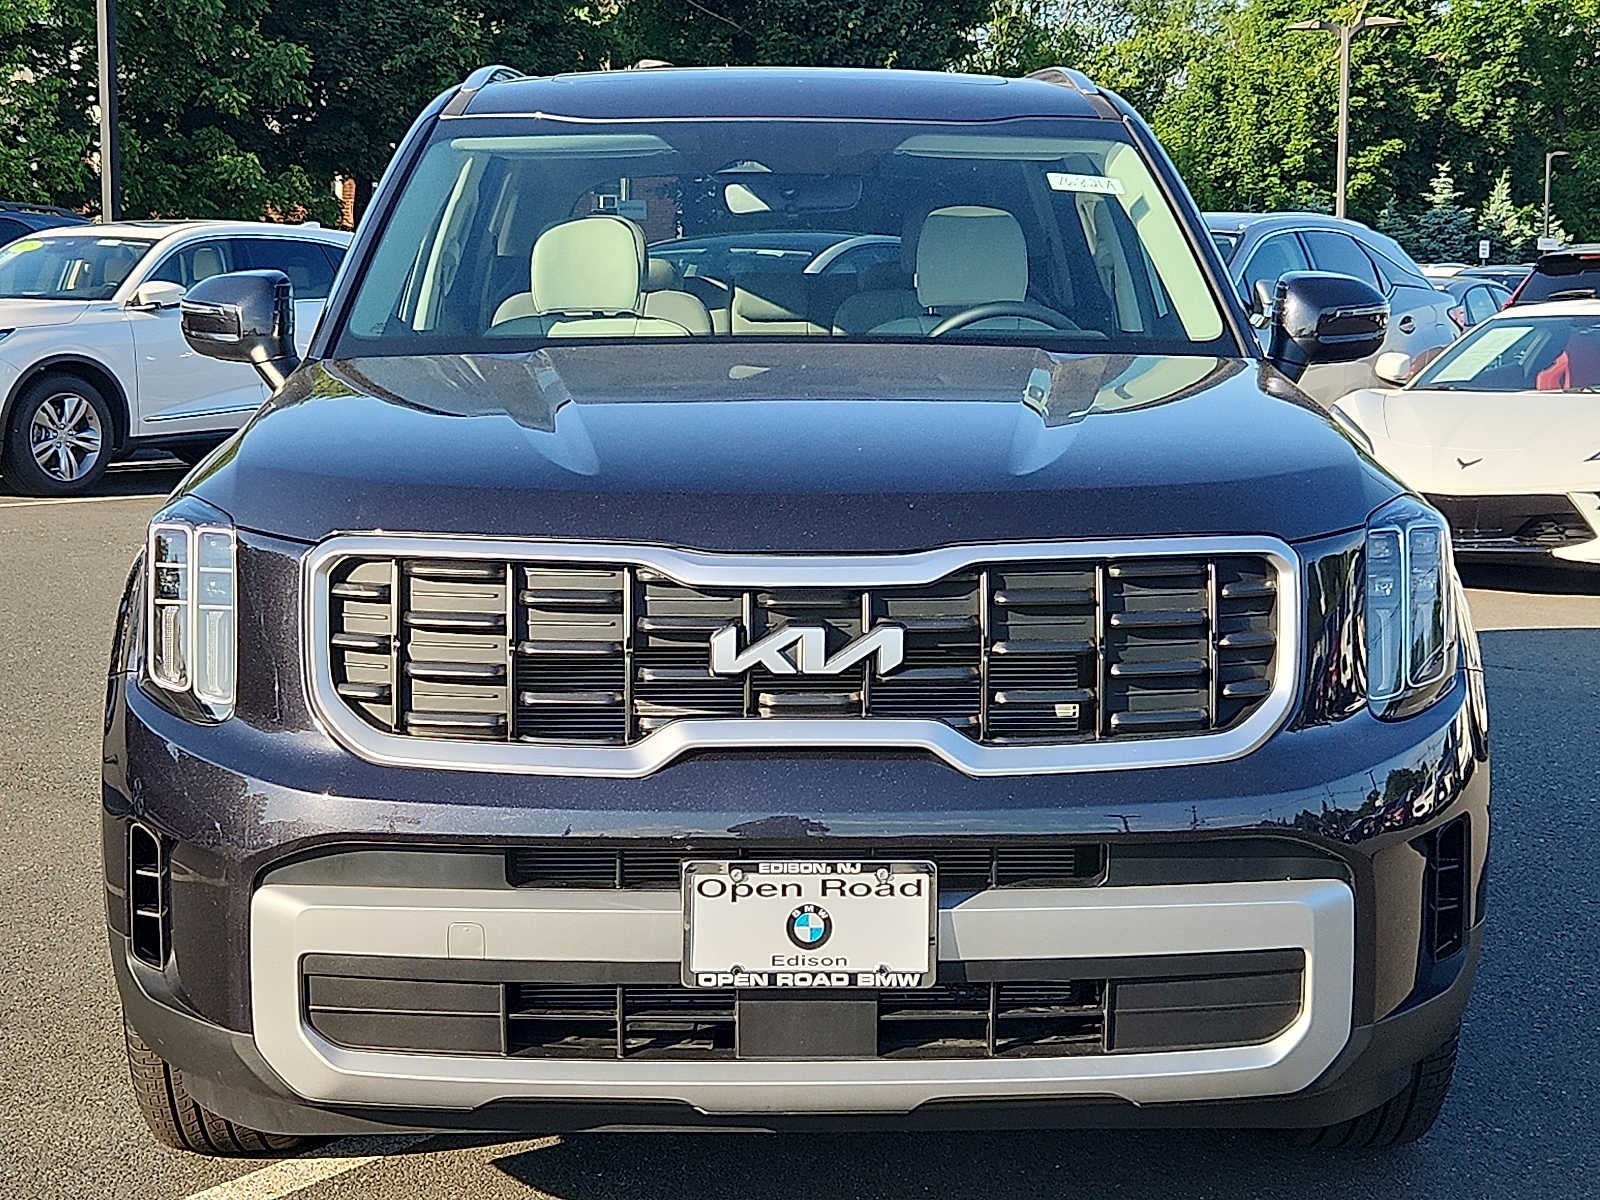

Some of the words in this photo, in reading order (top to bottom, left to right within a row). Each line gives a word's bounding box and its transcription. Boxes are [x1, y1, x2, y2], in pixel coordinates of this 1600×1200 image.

[711, 625, 904, 675] KIA
[758, 862, 831, 875] EDISON,
[836, 862, 862, 875] NJ
[697, 878, 803, 903] Open
[820, 878, 923, 898] Road
[791, 905, 829, 919] BMW
[771, 954, 848, 967] Edison
[698, 973, 769, 987] OPEN
[776, 973, 850, 987] ROAD
[857, 973, 921, 987] BMW
